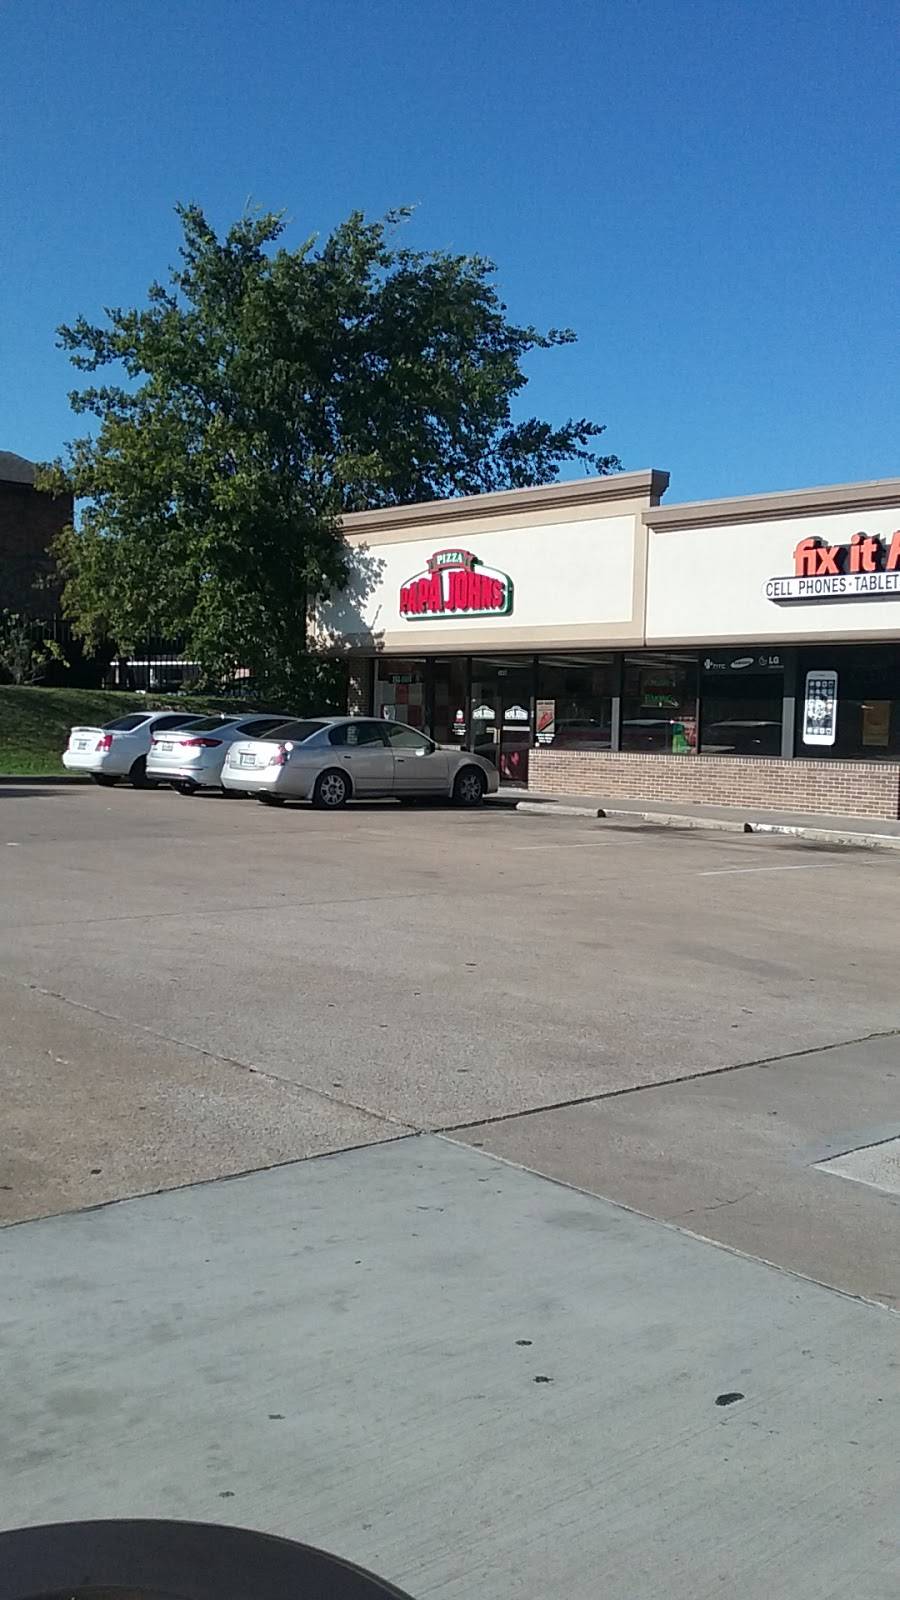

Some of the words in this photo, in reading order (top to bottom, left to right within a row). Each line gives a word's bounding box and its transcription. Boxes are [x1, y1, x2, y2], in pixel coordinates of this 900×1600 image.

[436, 552, 463, 565] PIZZA
[794, 537, 839, 576] fix
[850, 532, 877, 572] it
[400, 571, 445, 614] PAPA
[766, 581, 792, 597] CELL
[798, 577, 847, 595] PHONES
[854, 574, 900, 592] TABLET
